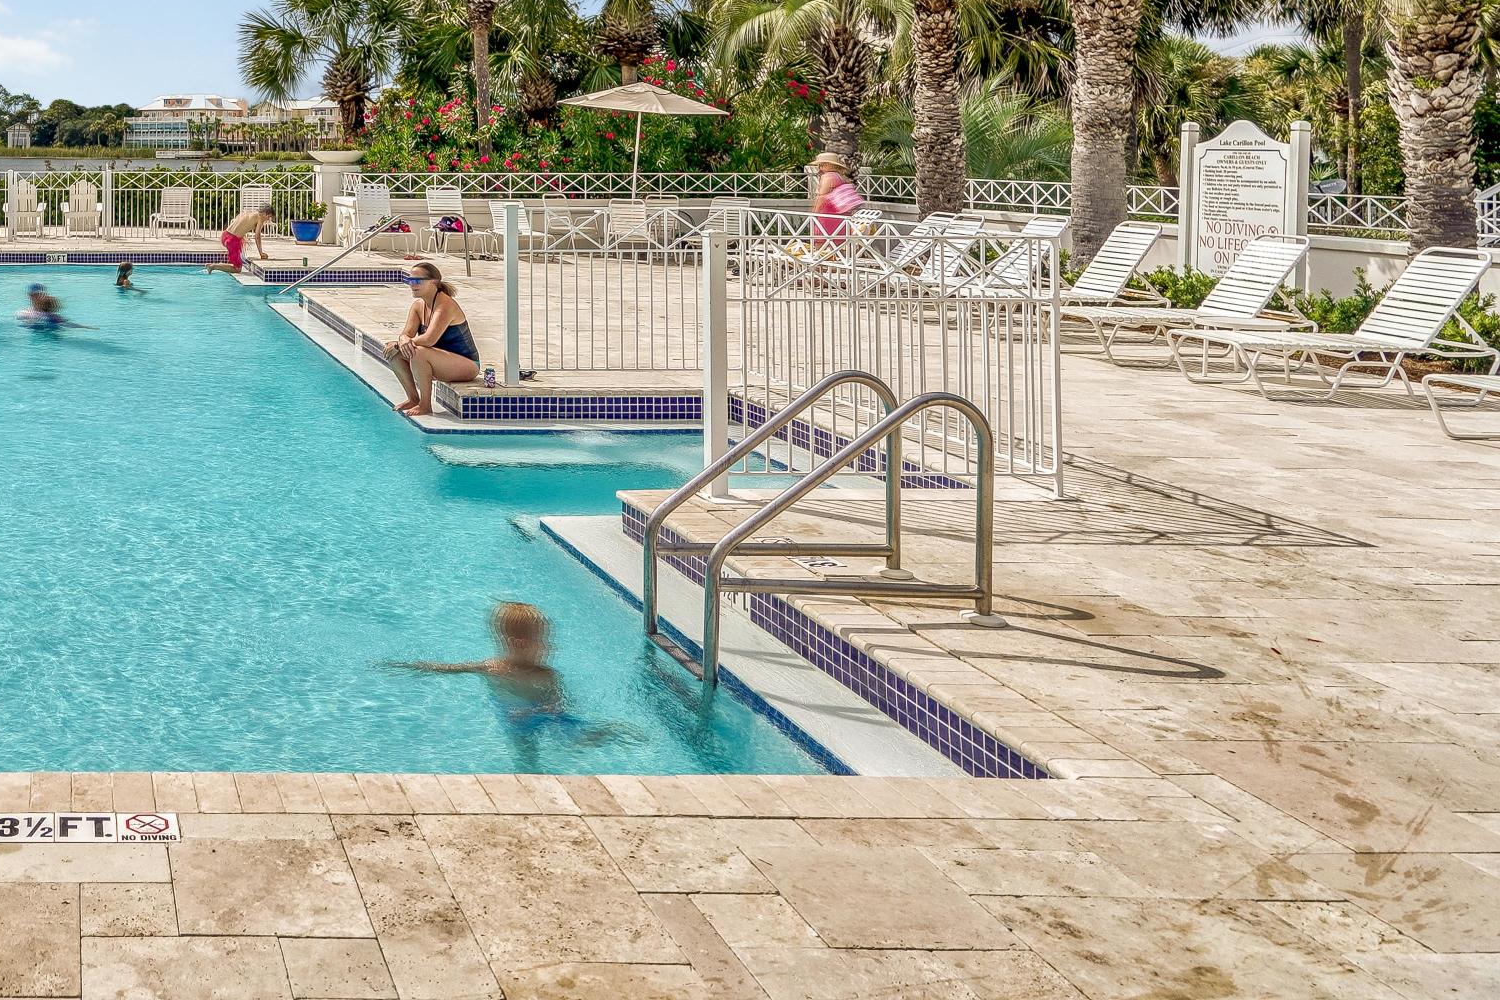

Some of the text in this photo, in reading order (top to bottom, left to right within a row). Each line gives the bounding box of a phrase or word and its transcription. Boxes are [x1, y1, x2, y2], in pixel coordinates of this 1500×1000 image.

[1206, 221, 1265, 237] NO DIVING
[1199, 235, 1214, 248] NO
[1214, 251, 1229, 264] ON
[59, 816, 113, 838] FT.
